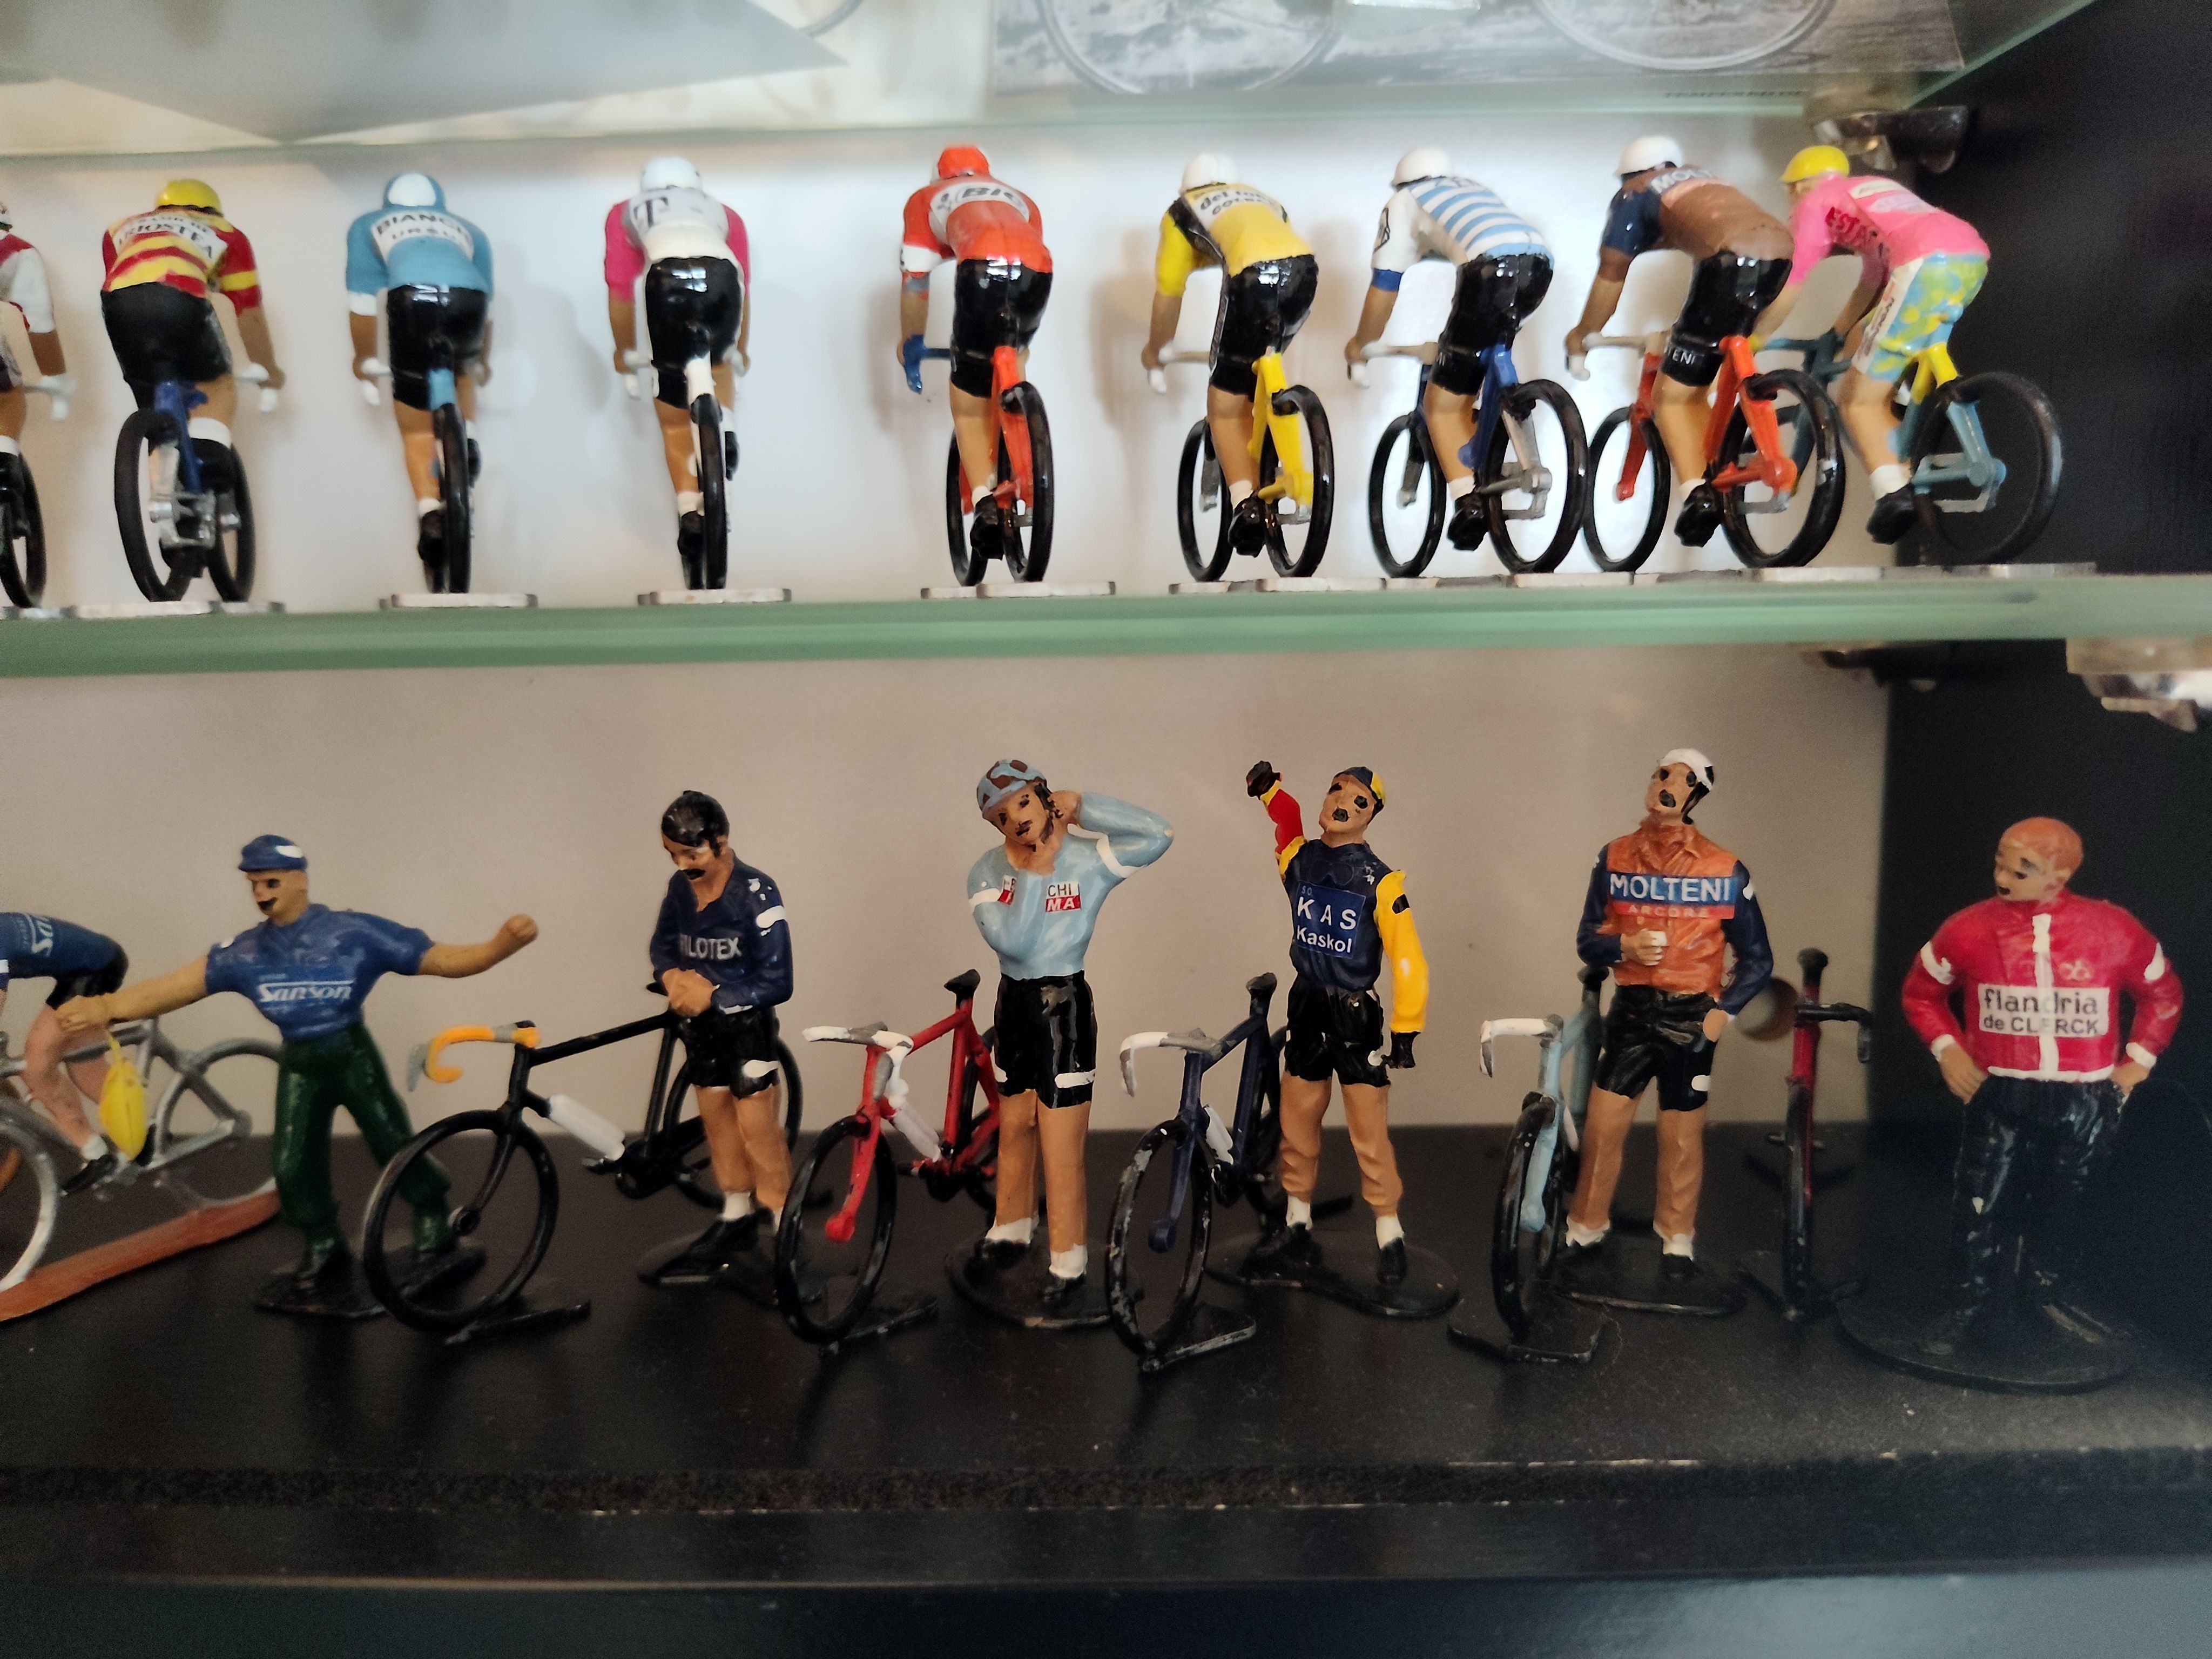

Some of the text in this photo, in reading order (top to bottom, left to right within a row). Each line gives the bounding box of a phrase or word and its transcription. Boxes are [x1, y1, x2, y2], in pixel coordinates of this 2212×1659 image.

[1609, 873, 1730, 902] MOLTENI
[1297, 925, 1352, 954] Kaskol
[259, 980, 355, 1003] Sanson
[1983, 1014, 2005, 1030] de
